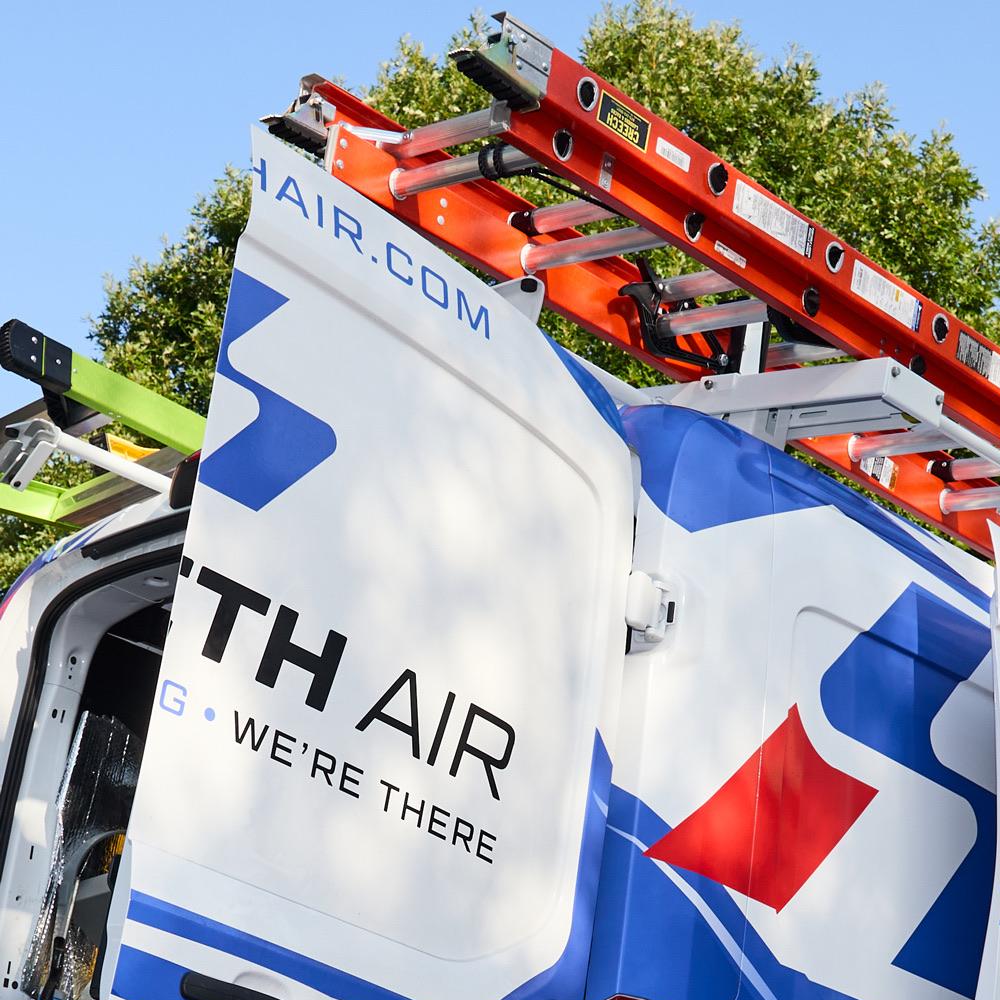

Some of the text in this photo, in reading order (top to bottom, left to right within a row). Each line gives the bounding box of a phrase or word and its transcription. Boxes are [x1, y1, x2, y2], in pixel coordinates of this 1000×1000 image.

[607, 113, 640, 143] CREECH
[181, 555, 516, 801] TH AIR
[159, 679, 497, 864] G WE'RE THERE
